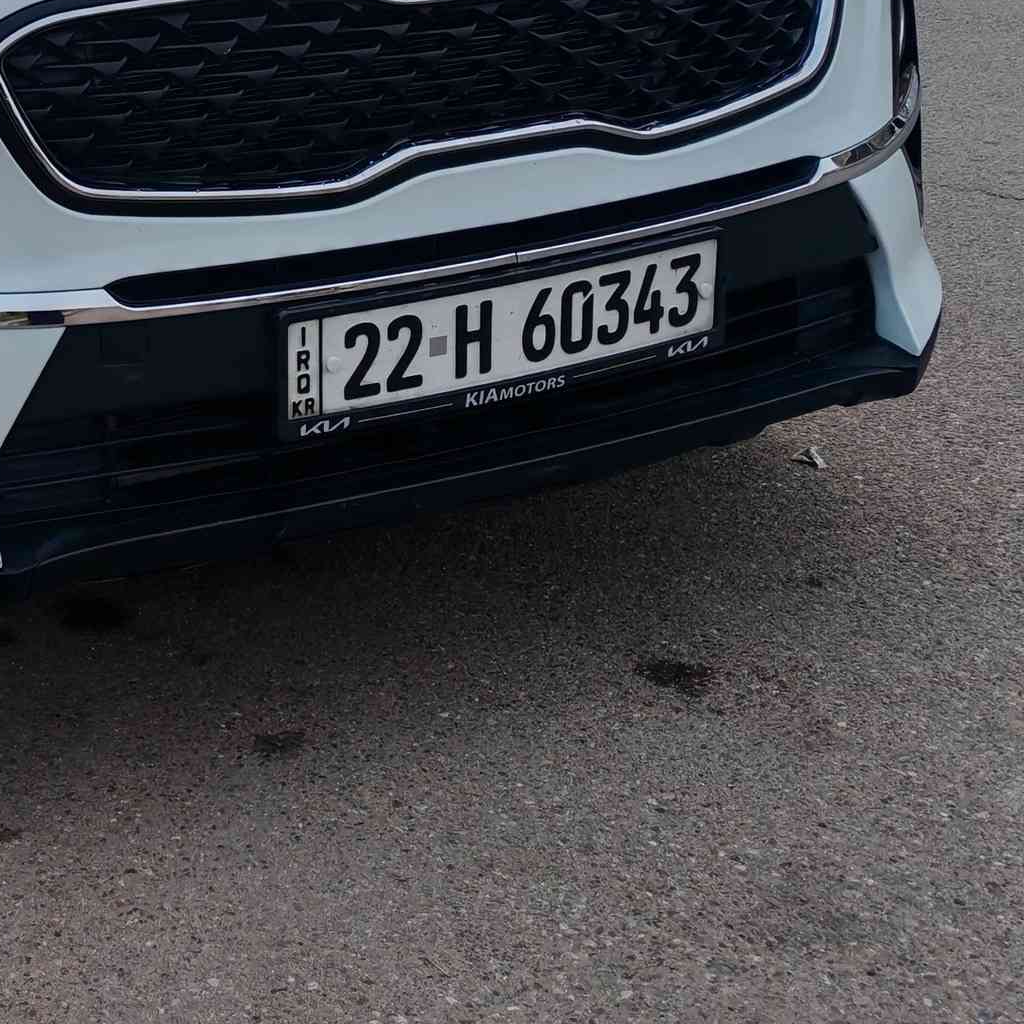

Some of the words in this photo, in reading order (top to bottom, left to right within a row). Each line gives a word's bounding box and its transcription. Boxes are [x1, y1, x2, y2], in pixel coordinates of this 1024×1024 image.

[344, 314, 423, 400] 22
[455, 300, 493, 378] H
[521, 253, 702, 362] 60343
[292, 398, 315, 418] KR
